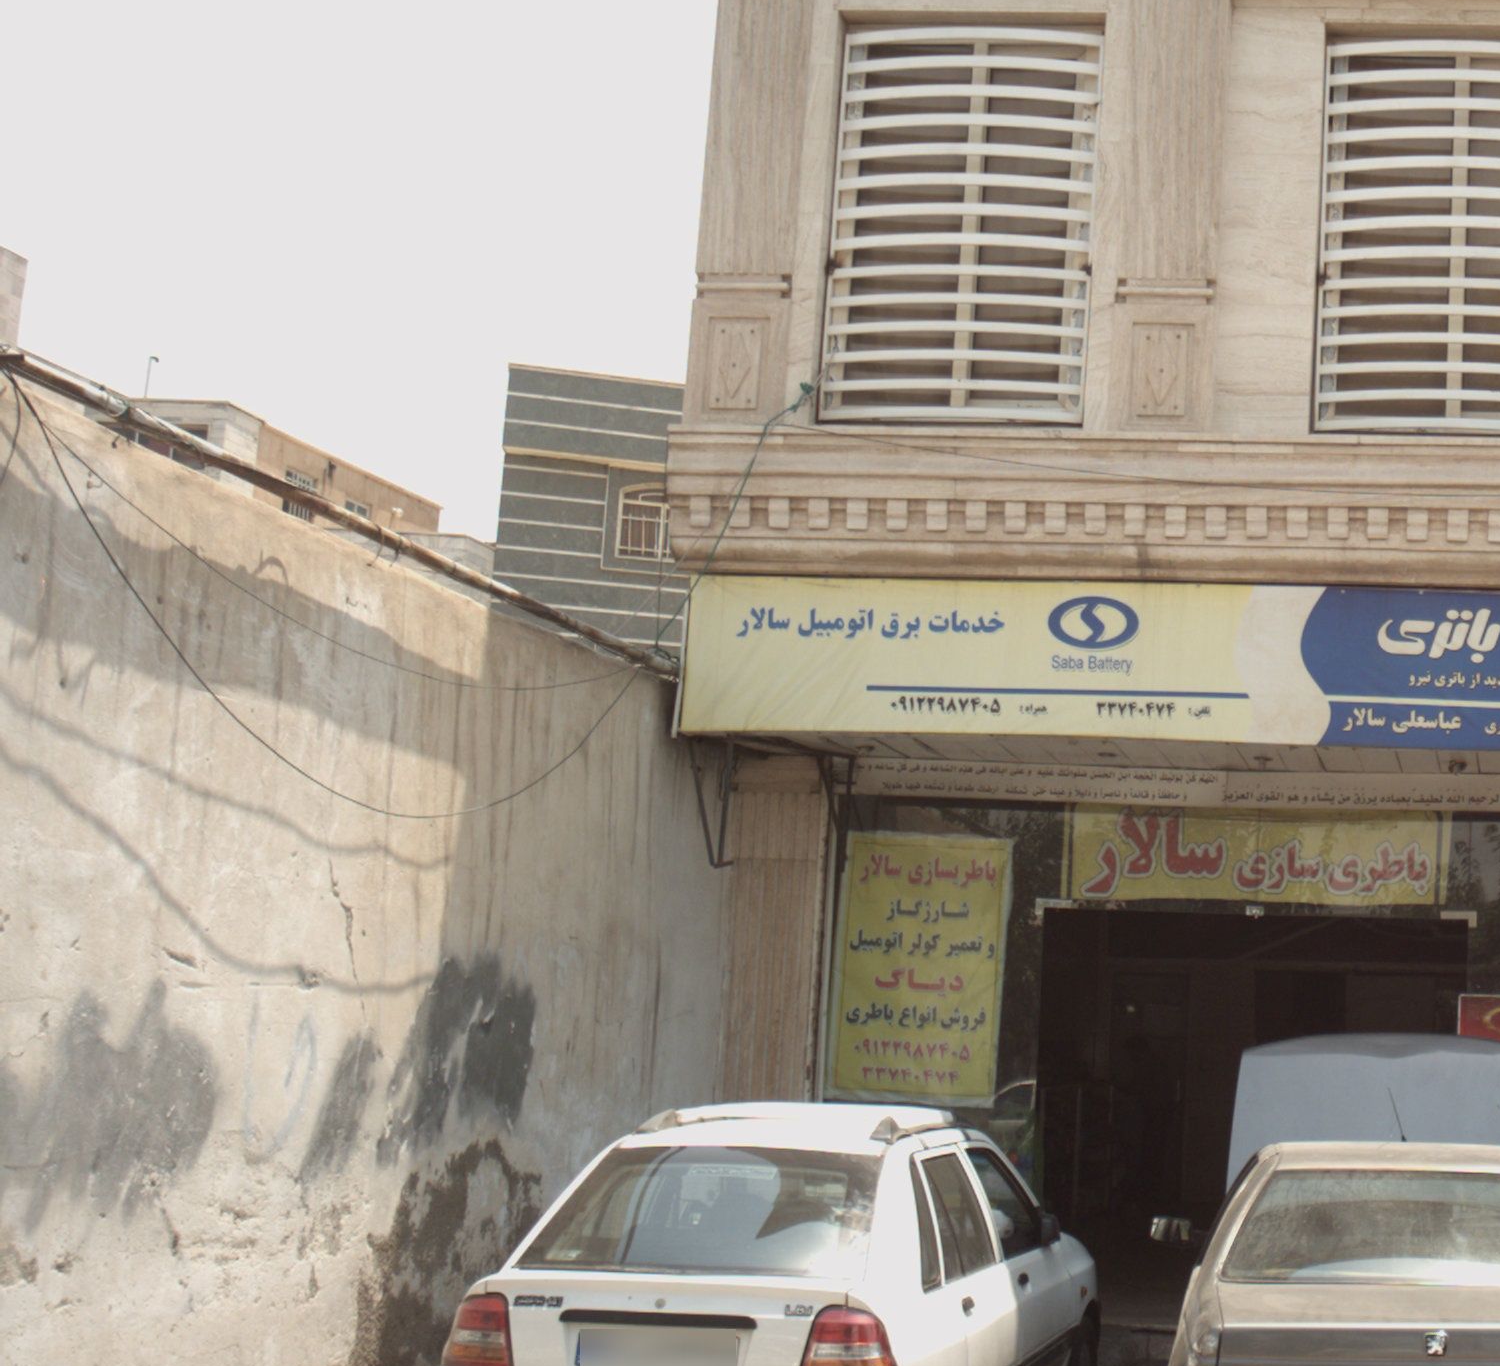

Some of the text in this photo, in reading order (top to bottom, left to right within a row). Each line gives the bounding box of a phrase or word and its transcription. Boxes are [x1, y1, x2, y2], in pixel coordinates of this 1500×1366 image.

[737, 605, 1006, 640] خدمات برق اتومبیل سالار
[1051, 654, 1133, 676] Saba Battery
[1434, 671, 1466, 689] باتری
[1468, 672, 1481, 689] از
[1341, 706, 1387, 732] سالار
[1080, 806, 1432, 898] باطری سازی سالار
[858, 852, 903, 886] سالار
[848, 928, 904, 959] اتومبیل
[907, 932, 942, 958] کولر
[944, 934, 984, 958] تعمیر
[844, 1001, 988, 1031] فروش انواع باطری
